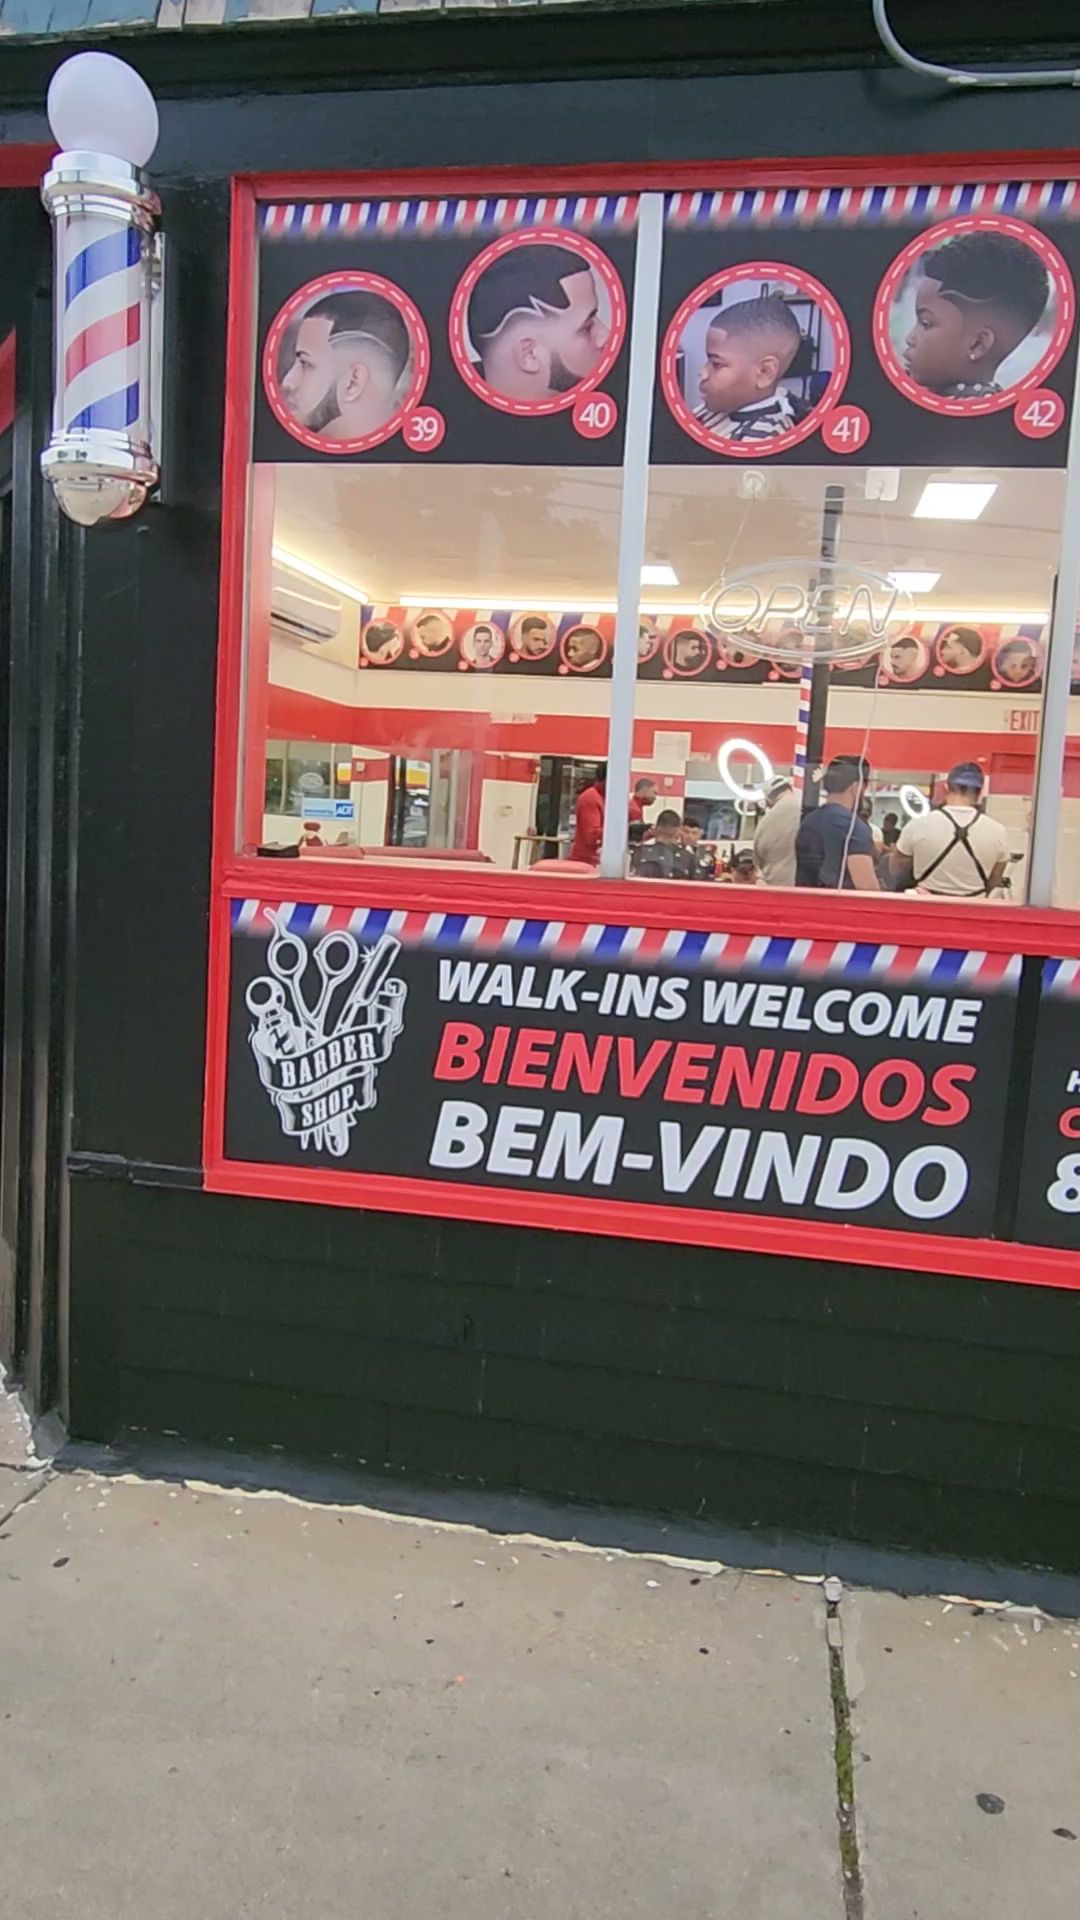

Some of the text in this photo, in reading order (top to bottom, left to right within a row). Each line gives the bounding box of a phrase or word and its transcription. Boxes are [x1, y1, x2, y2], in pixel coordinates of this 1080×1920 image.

[409, 416, 438, 442] 39
[579, 402, 610, 428] 40
[831, 416, 861, 442] 41
[1021, 400, 1056, 427] 42
[710, 582, 900, 637] OPEN
[1010, 710, 1041, 731] EXIT
[438, 959, 983, 1044] WALK-INS WELCOME
[281, 1032, 377, 1087] BARBER
[434, 1022, 976, 1126] BIENVENIDOS
[301, 1084, 354, 1127] SHOP
[429, 1100, 968, 1219] BEM-VINDO
